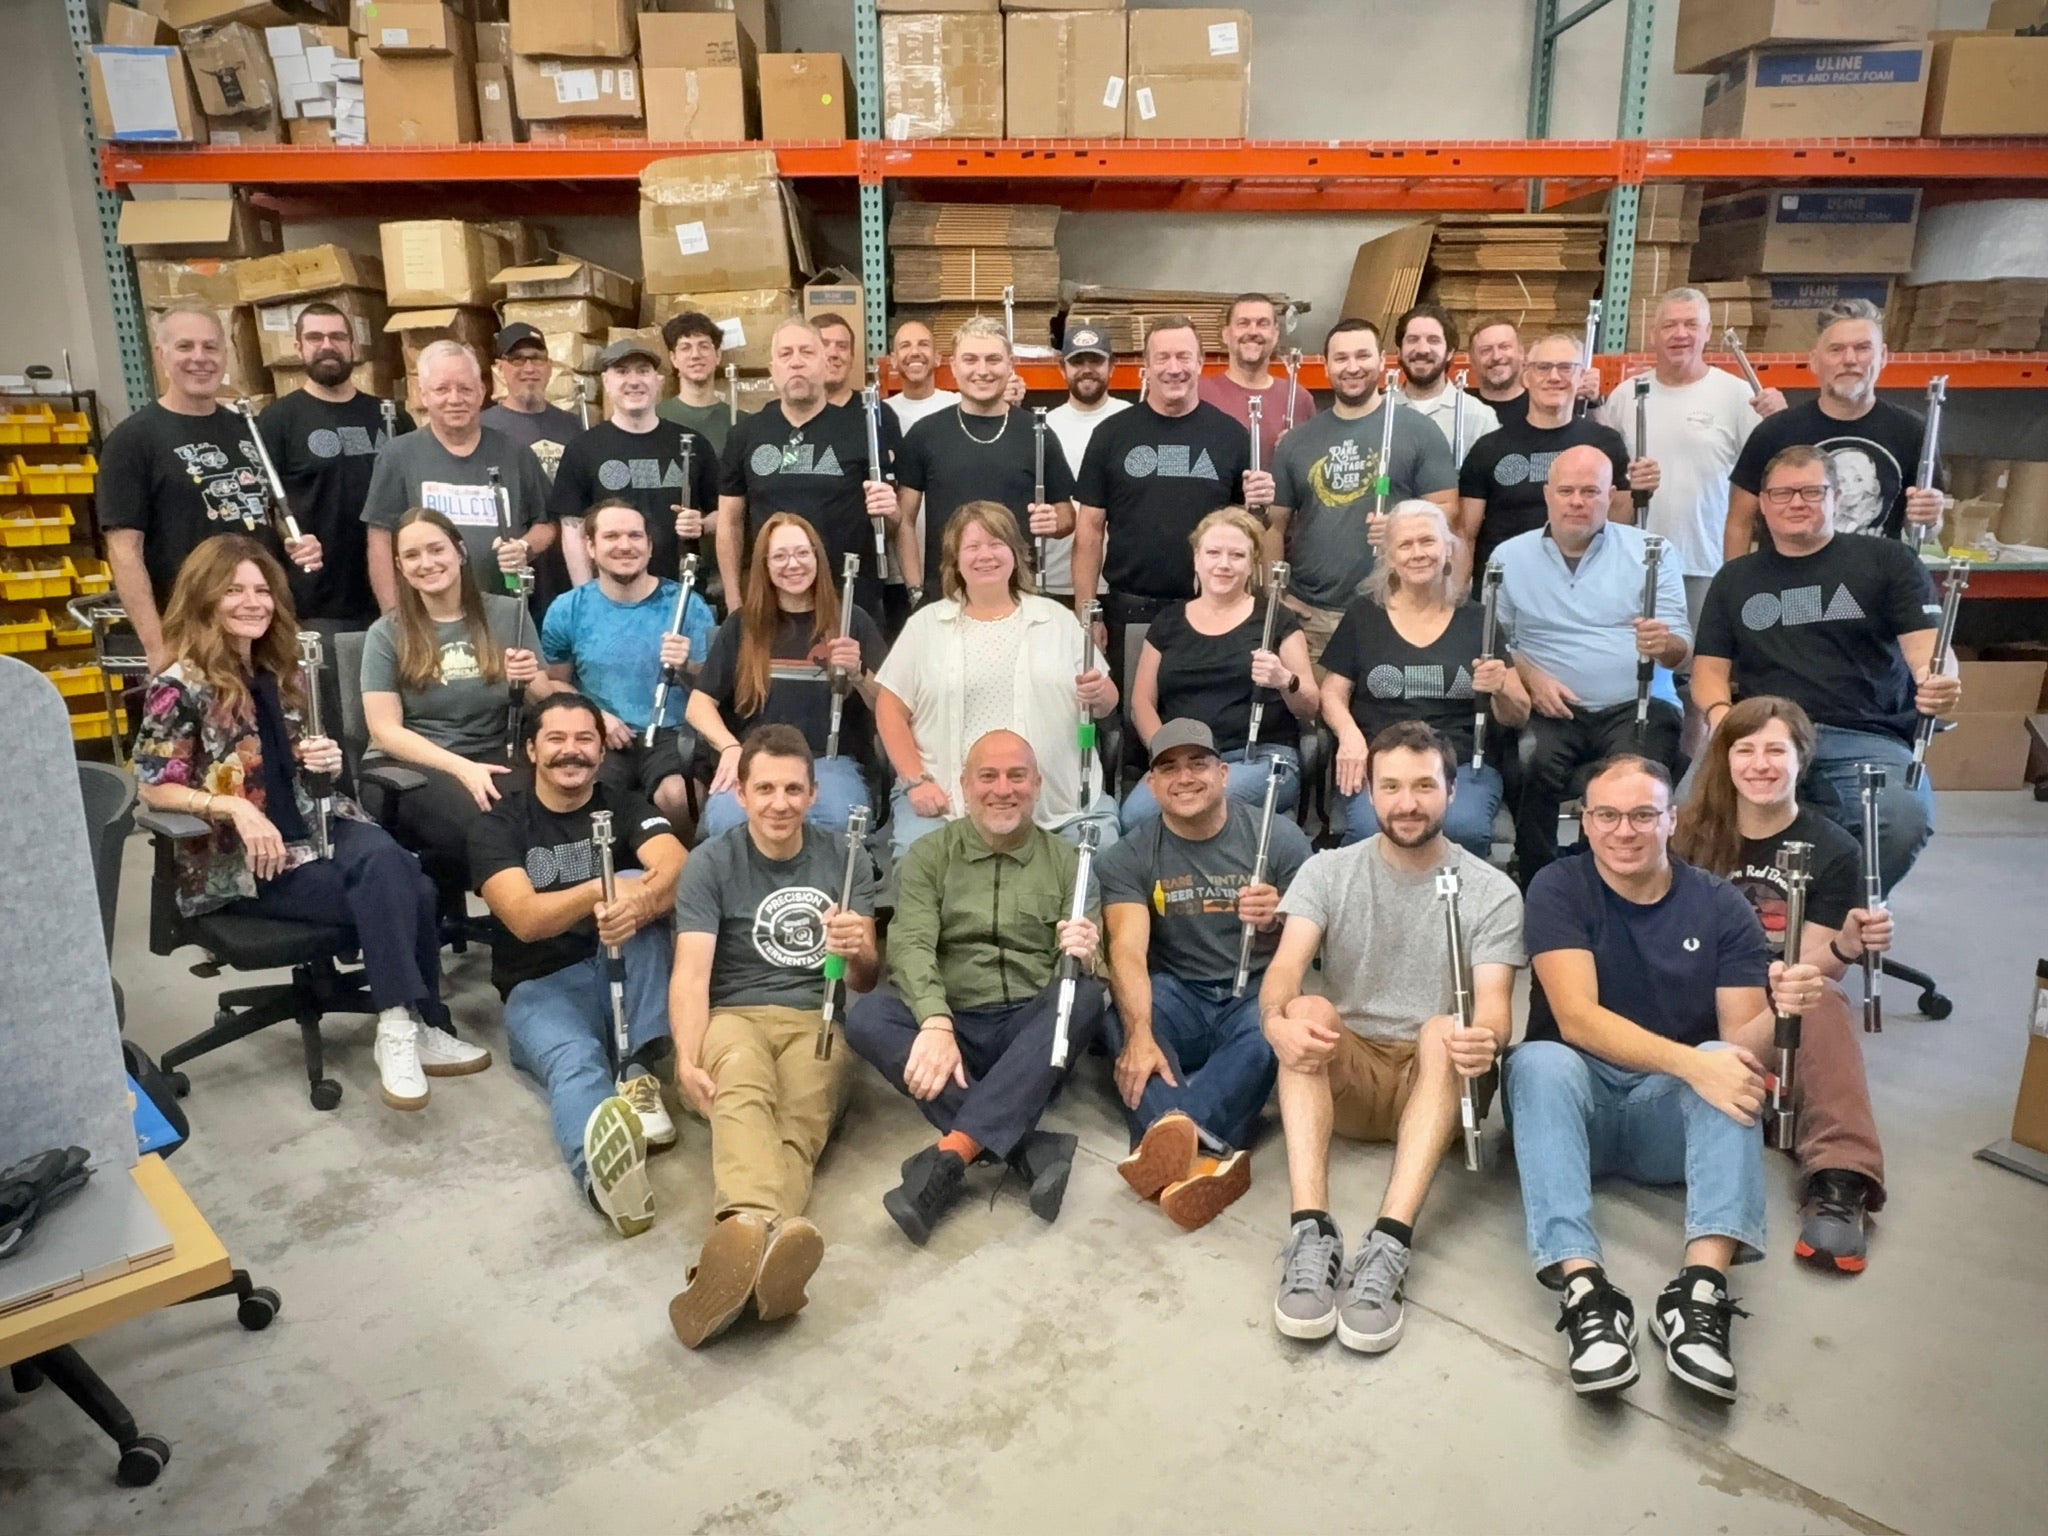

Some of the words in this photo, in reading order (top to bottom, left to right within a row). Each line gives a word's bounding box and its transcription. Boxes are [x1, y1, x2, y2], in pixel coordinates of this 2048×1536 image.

[1815, 56, 1863, 71] ULINE
[1781, 74, 1804, 84] PICK
[1806, 73, 1830, 83] AND
[1832, 72, 1860, 82] PACK
[1863, 70, 1894, 81] FOAM
[1800, 284, 1839, 297] ULINE
[1329, 445, 1359, 463] RARE
[1324, 460, 1366, 479] VINTAGE
[1331, 472, 1360, 490] BEER
[1196, 886, 1240, 899] TASTIN
[765, 892, 824, 915] PRECISION
[761, 940, 828, 966] FERMENTATIO
